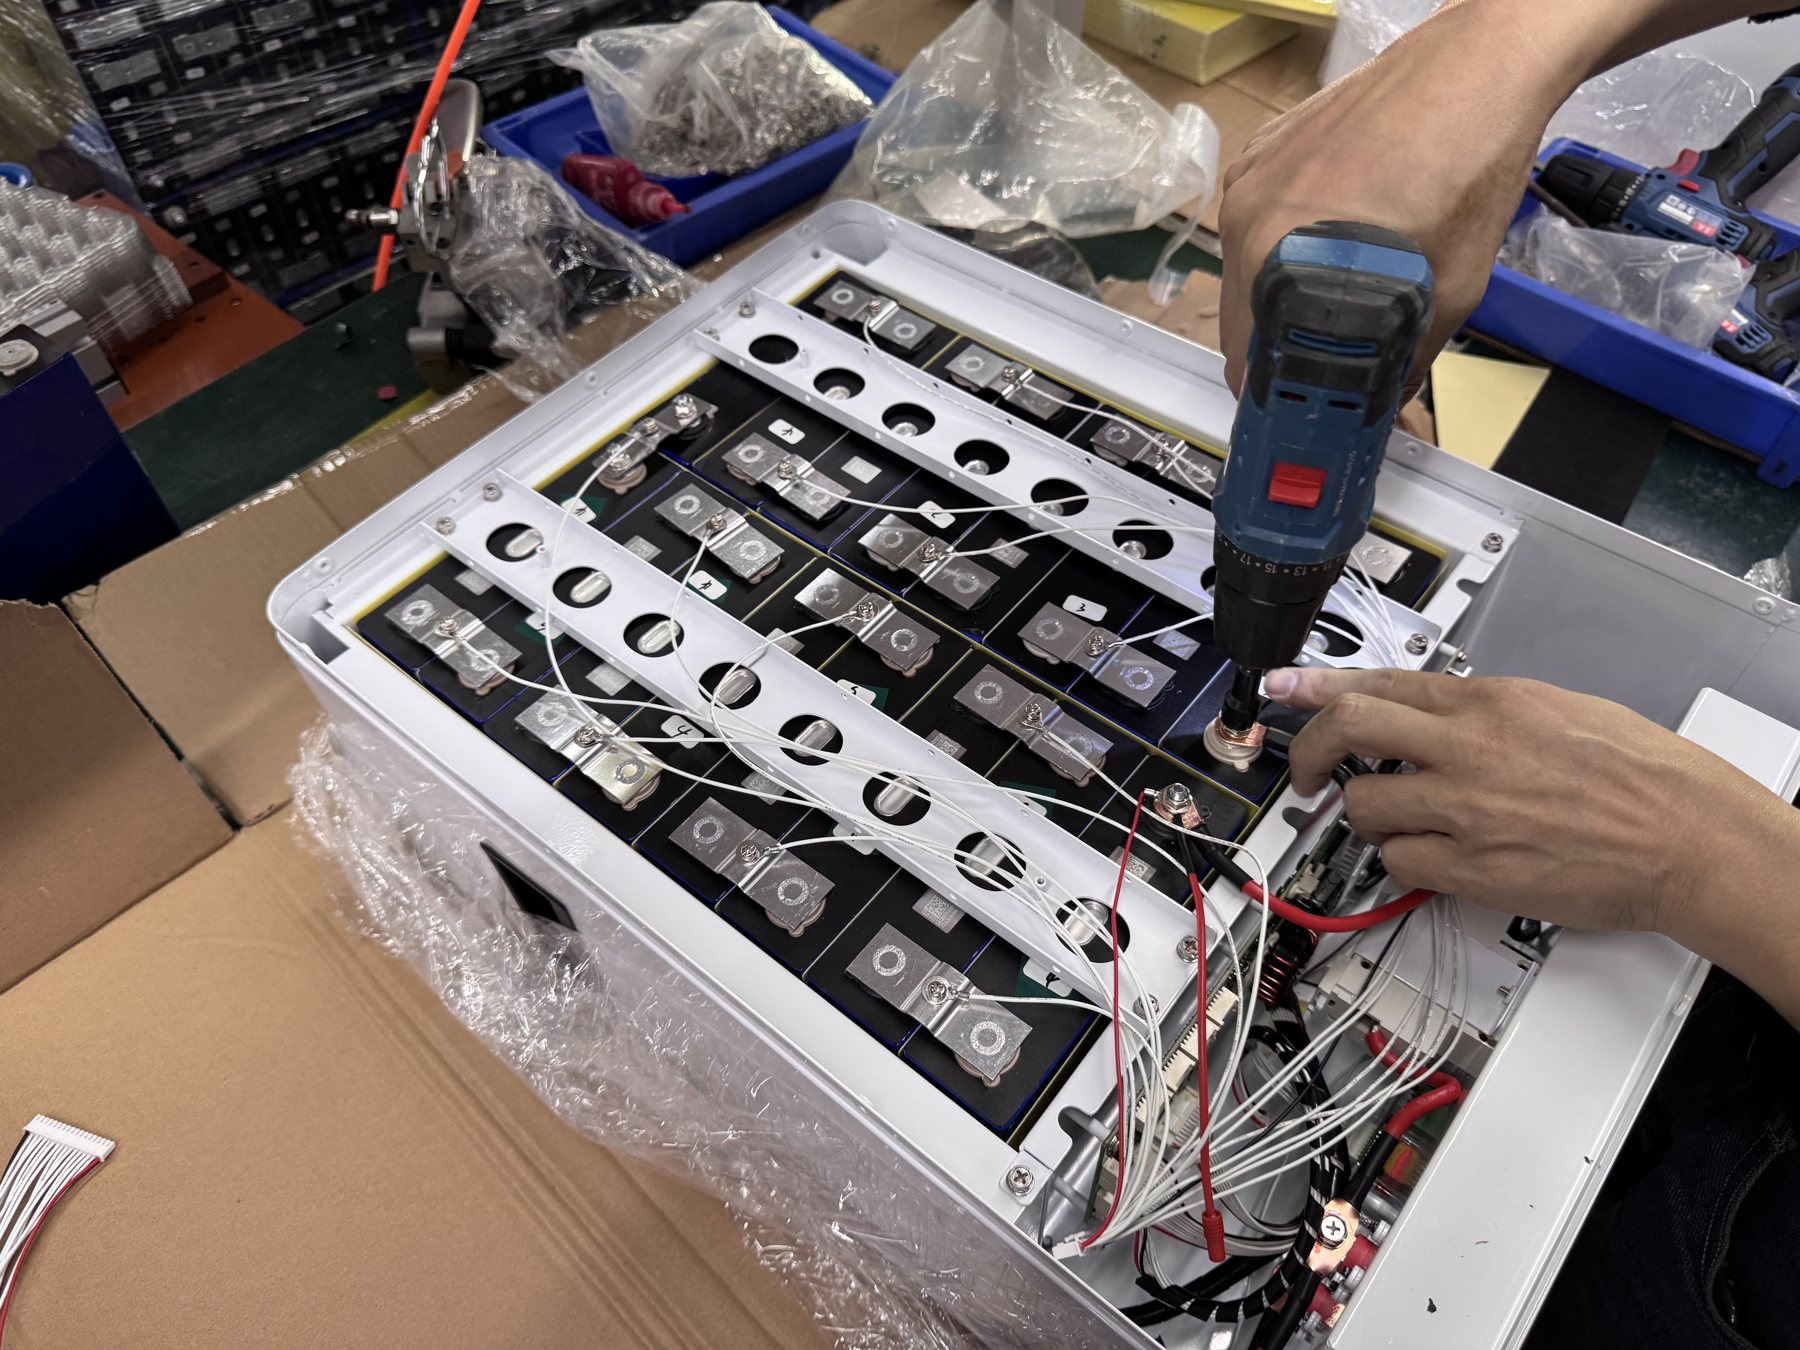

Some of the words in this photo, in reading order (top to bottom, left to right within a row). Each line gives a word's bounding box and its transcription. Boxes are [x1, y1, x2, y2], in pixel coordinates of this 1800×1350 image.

[1239, 554, 1251, 565] 17
[1264, 563, 1277, 574] 15
[1293, 566, 1307, 577] 13
[672, 725, 692, 738] 4
